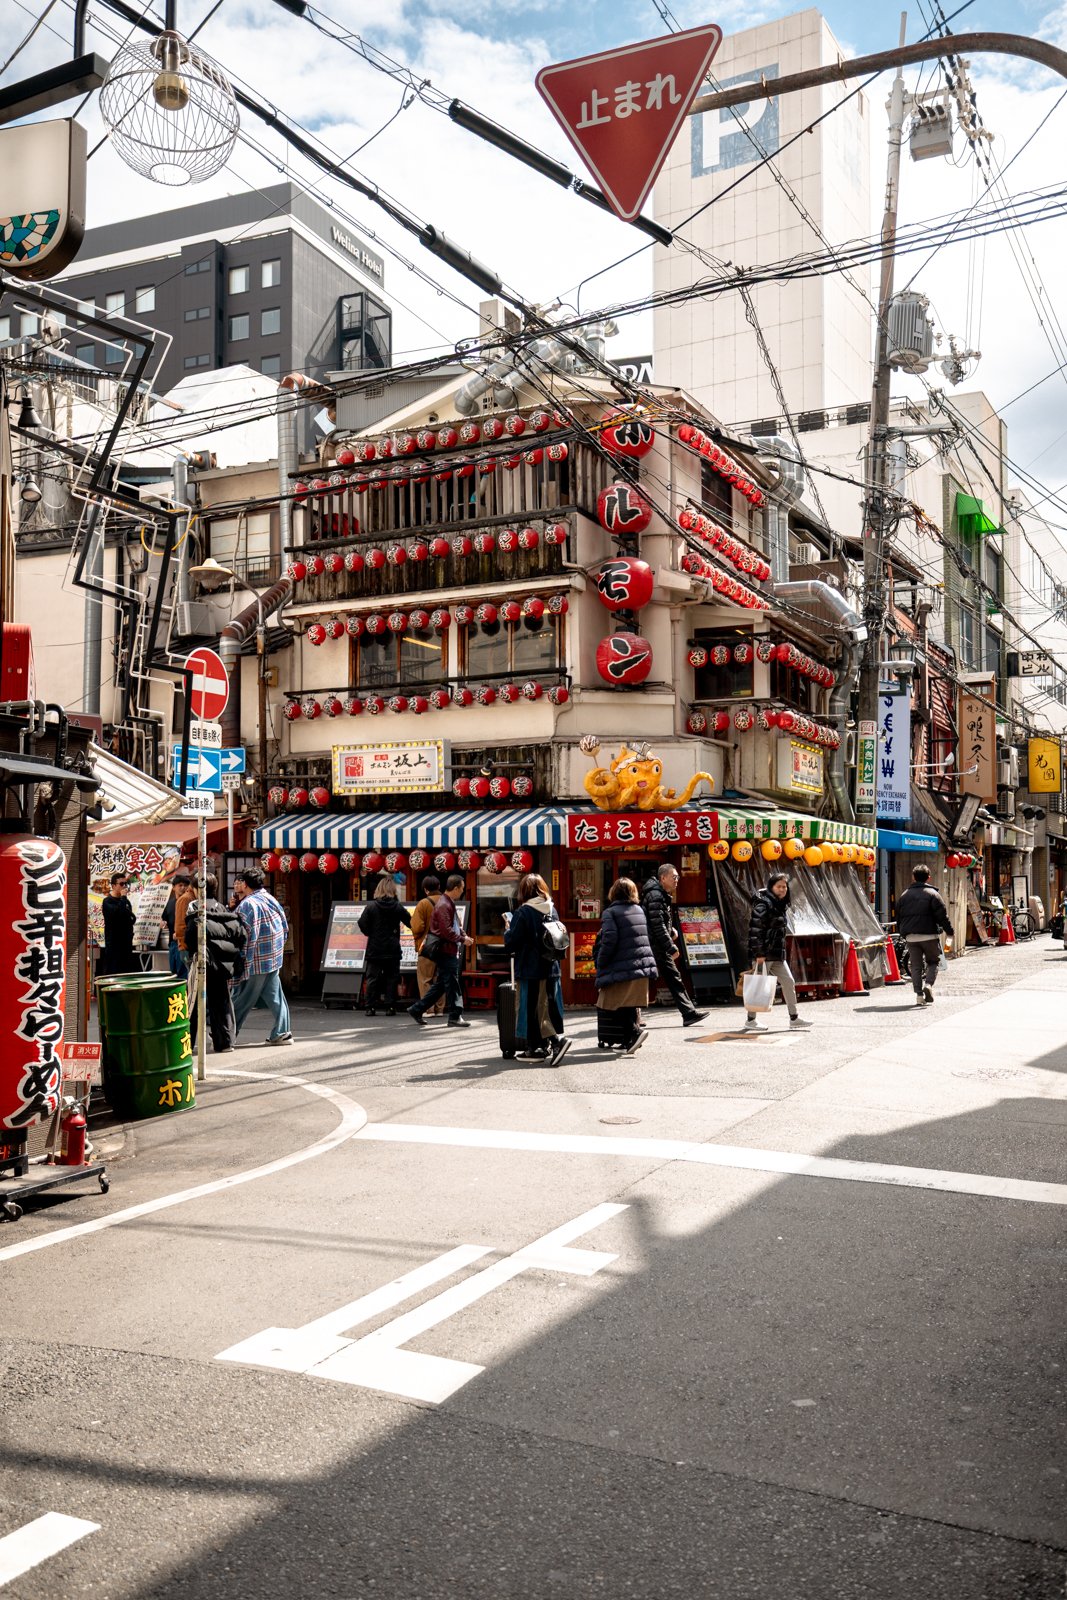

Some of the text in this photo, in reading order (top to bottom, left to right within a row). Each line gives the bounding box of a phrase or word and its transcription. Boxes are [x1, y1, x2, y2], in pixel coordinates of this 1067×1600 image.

[576, 73, 682, 129] 止まれ
[702, 80, 767, 169] P
[331, 226, 383, 277] Welina Hotel
[598, 411, 652, 680] ホルモン
[1022, 653, 1047, 662] 中村
[1022, 664, 1050, 674] ビル
[393, 753, 428, 768] 坂上
[864, 740, 874, 782] あきんど
[866, 789, 873, 797] 10
[884, 783, 892, 791] NOW
[888, 791, 907, 800] EXCHANGE
[574, 815, 714, 842] たこ焼き
[127, 848, 163, 872] 宴会
[166, 991, 189, 1024] 炭
[77, 1046, 99, 1056] 消火器
